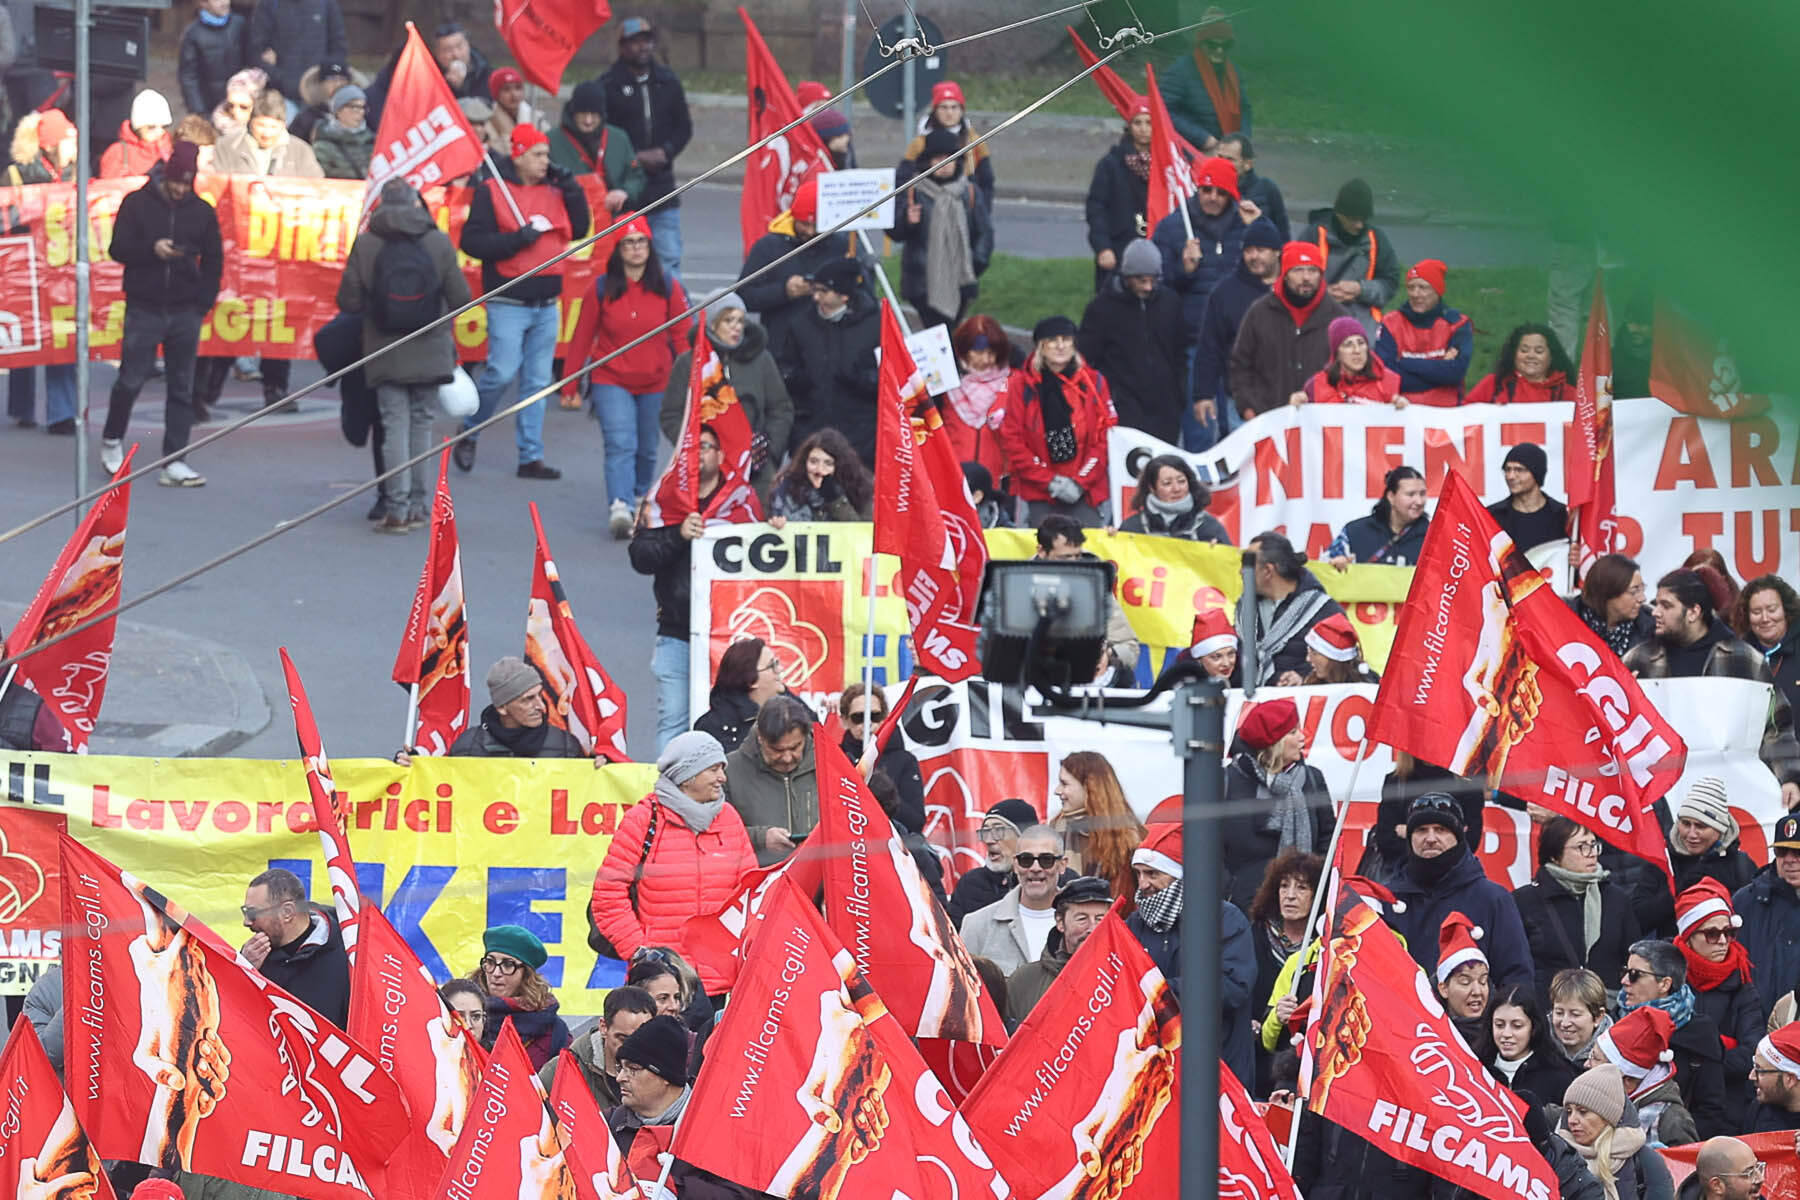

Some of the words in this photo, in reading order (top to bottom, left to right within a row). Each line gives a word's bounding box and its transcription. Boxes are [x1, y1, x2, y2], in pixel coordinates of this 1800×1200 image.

[200, 296, 296, 345] GIL
[712, 534, 842, 574] CGIL
[1412, 522, 1473, 707] www.filcams.cgil.it
[483, 800, 521, 835] e
[846, 776, 873, 977] www.filcams.cgil.it
[76, 872, 110, 1101] www.filcams.cgil.it
[729, 925, 812, 1120] www.filcams.cgil.it
[1004, 950, 1125, 1138] www.filcams.cgil.it
